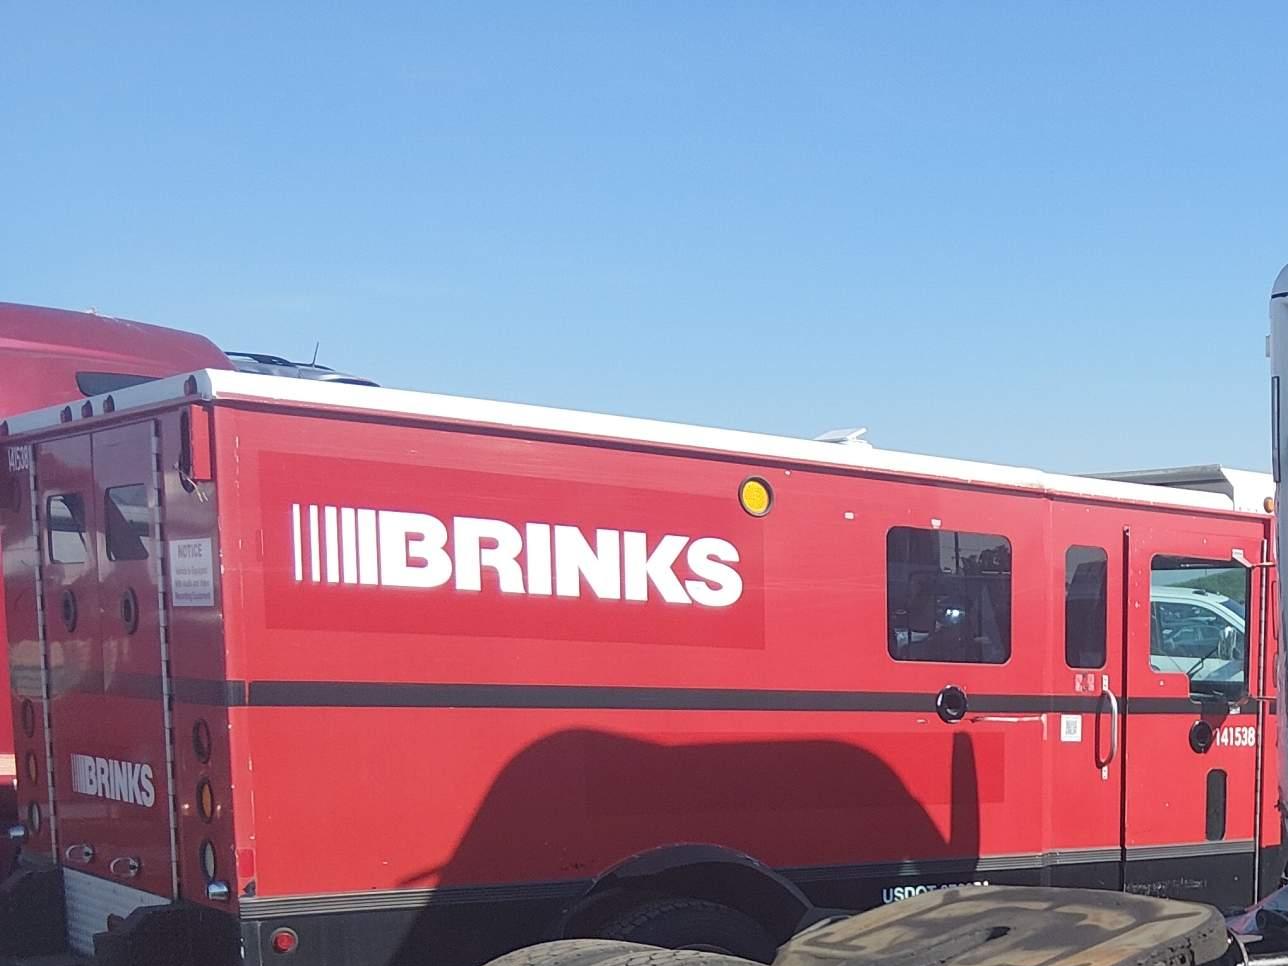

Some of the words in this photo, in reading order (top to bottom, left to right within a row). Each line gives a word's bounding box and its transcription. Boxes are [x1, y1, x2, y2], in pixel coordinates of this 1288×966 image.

[177, 543, 203, 559] NOTICE
[377, 509, 744, 608] BRINKS
[1214, 726, 1256, 748] 141538
[83, 755, 155, 808] BRINKS
